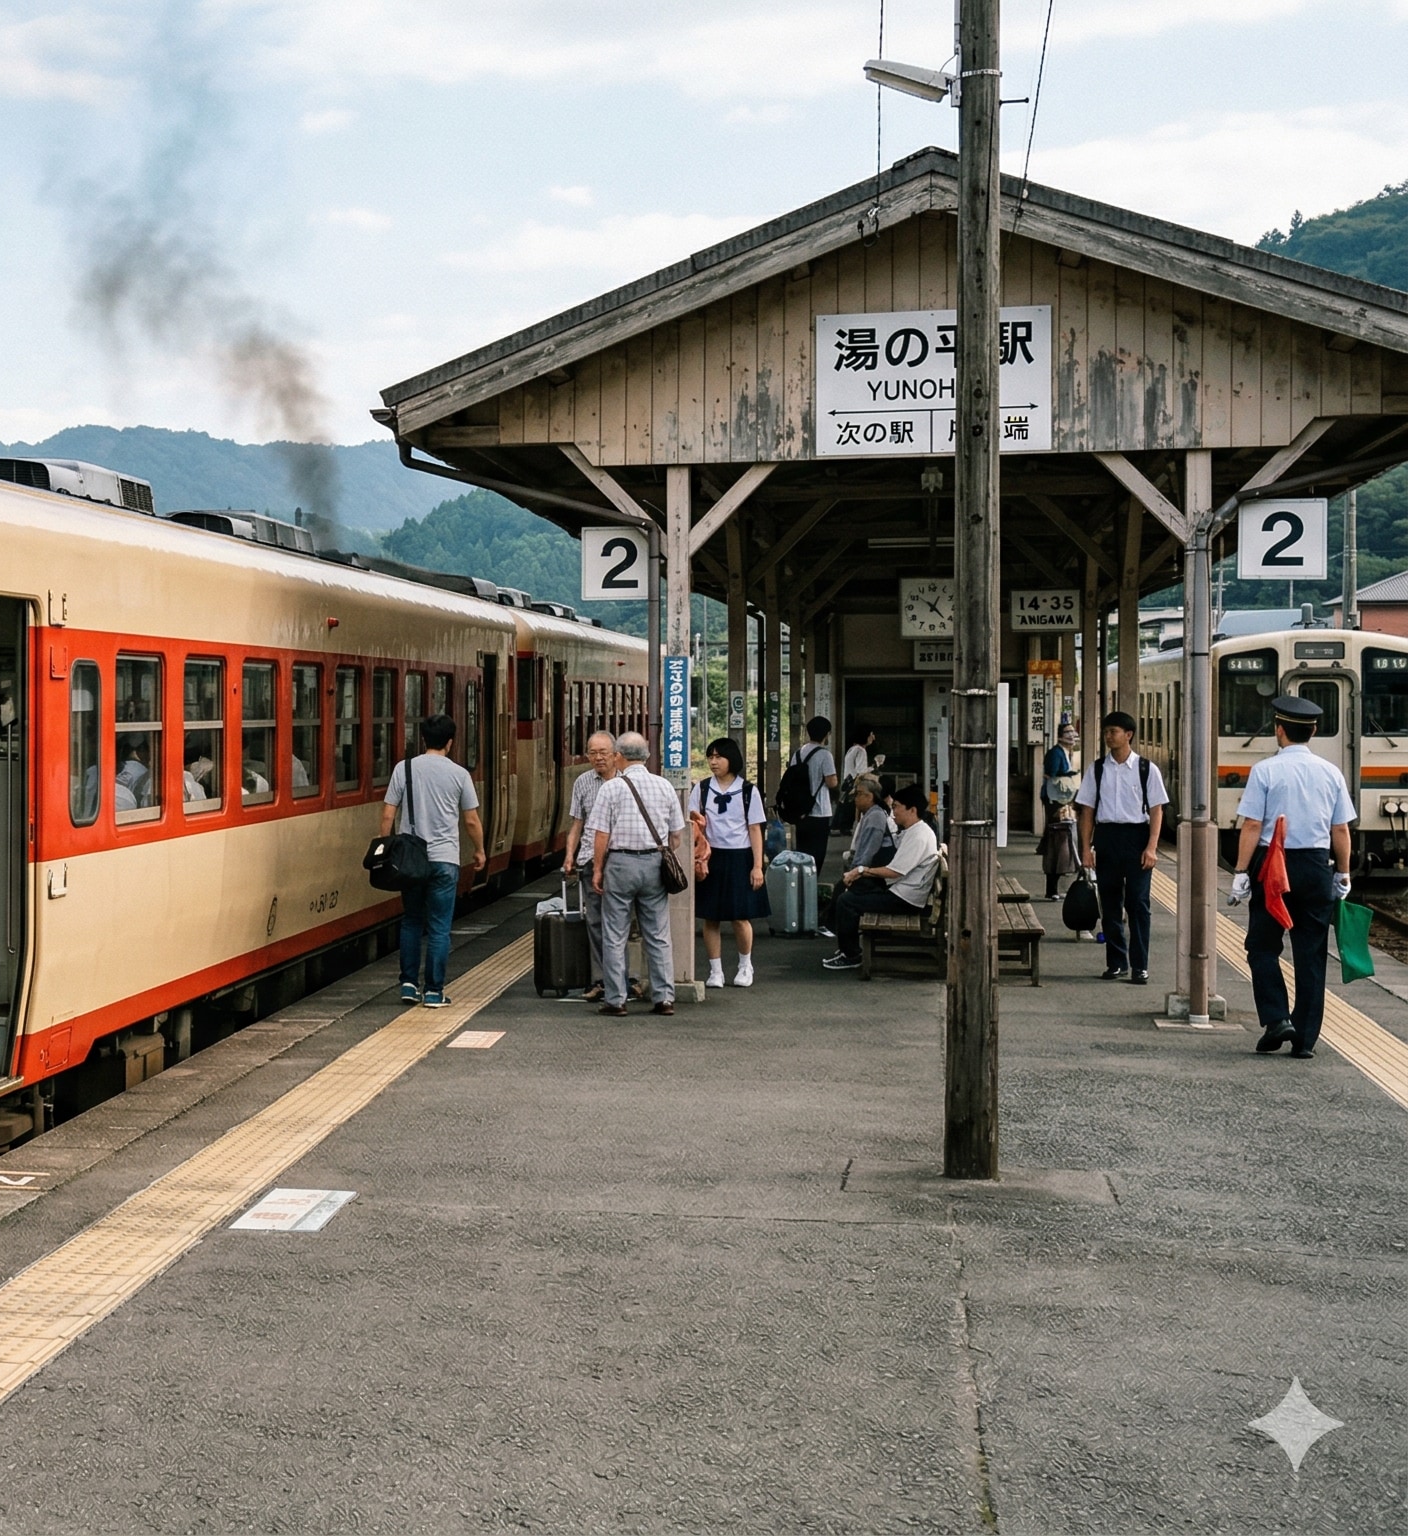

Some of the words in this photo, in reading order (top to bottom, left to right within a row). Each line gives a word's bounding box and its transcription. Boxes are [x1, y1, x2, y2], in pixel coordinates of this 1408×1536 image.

[867, 378, 956, 401] YUNOH
[836, 420, 914, 446] 次の駅
[1261, 510, 1304, 567] 2
[600, 537, 639, 589] 2
